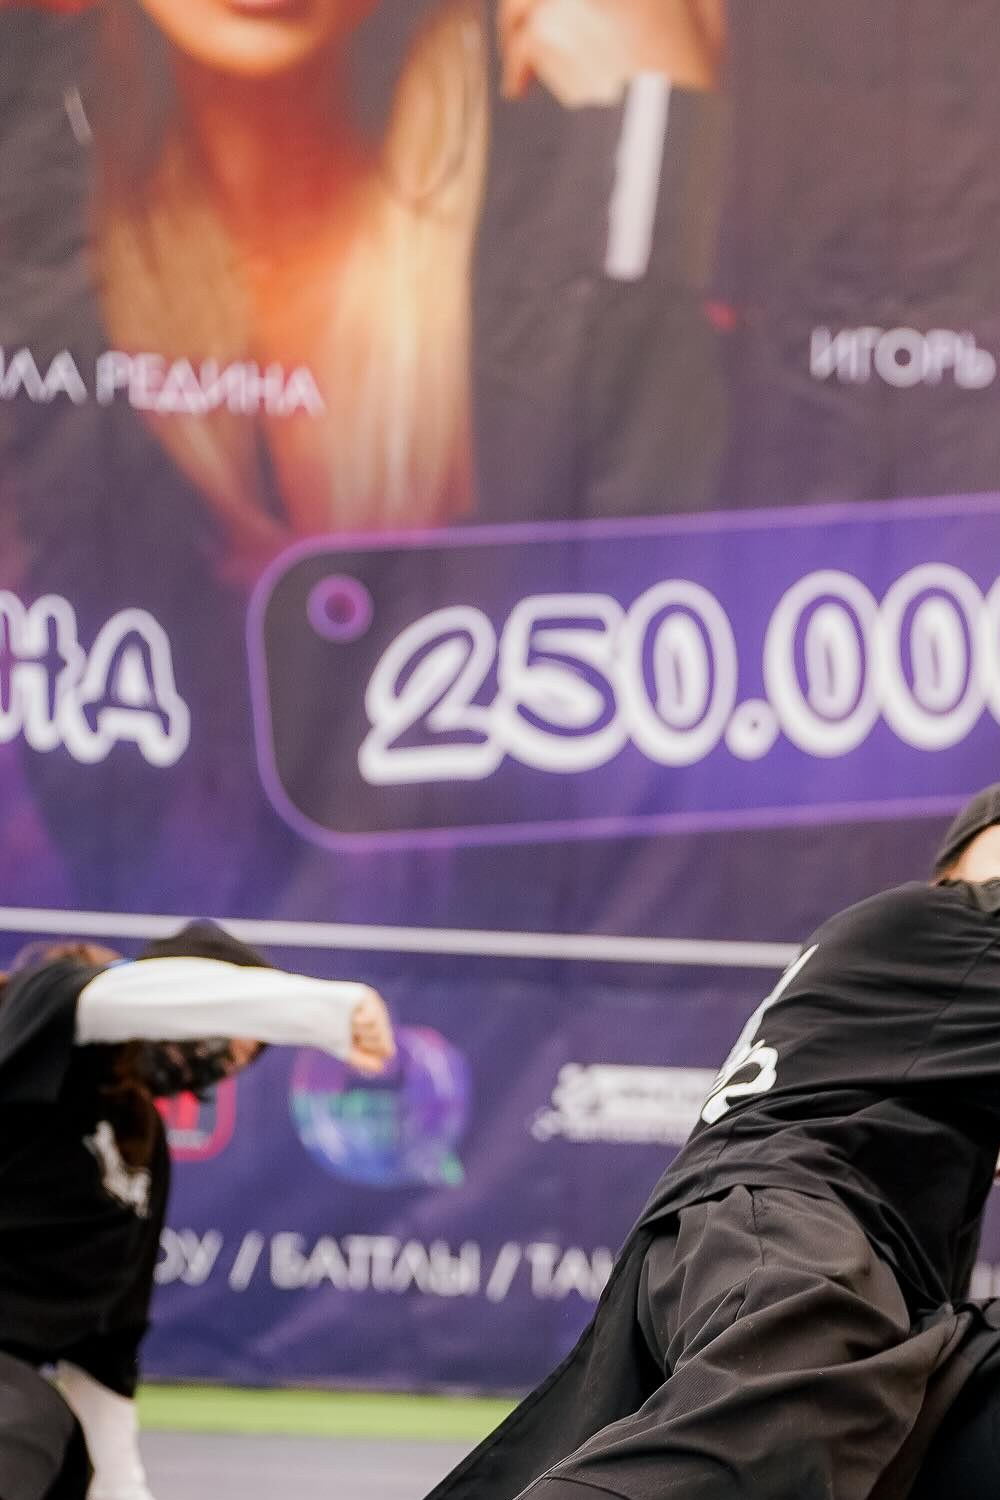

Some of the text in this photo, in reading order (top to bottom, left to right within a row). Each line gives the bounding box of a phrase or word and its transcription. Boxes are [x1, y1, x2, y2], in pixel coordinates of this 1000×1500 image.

[0, 347, 326, 417] ЛА РЕДИНА
[810, 325, 995, 389] ИГОРЬ
[154, 1226, 222, 1286] ОУ
[270, 1231, 480, 1299] БАТТЛЫ
